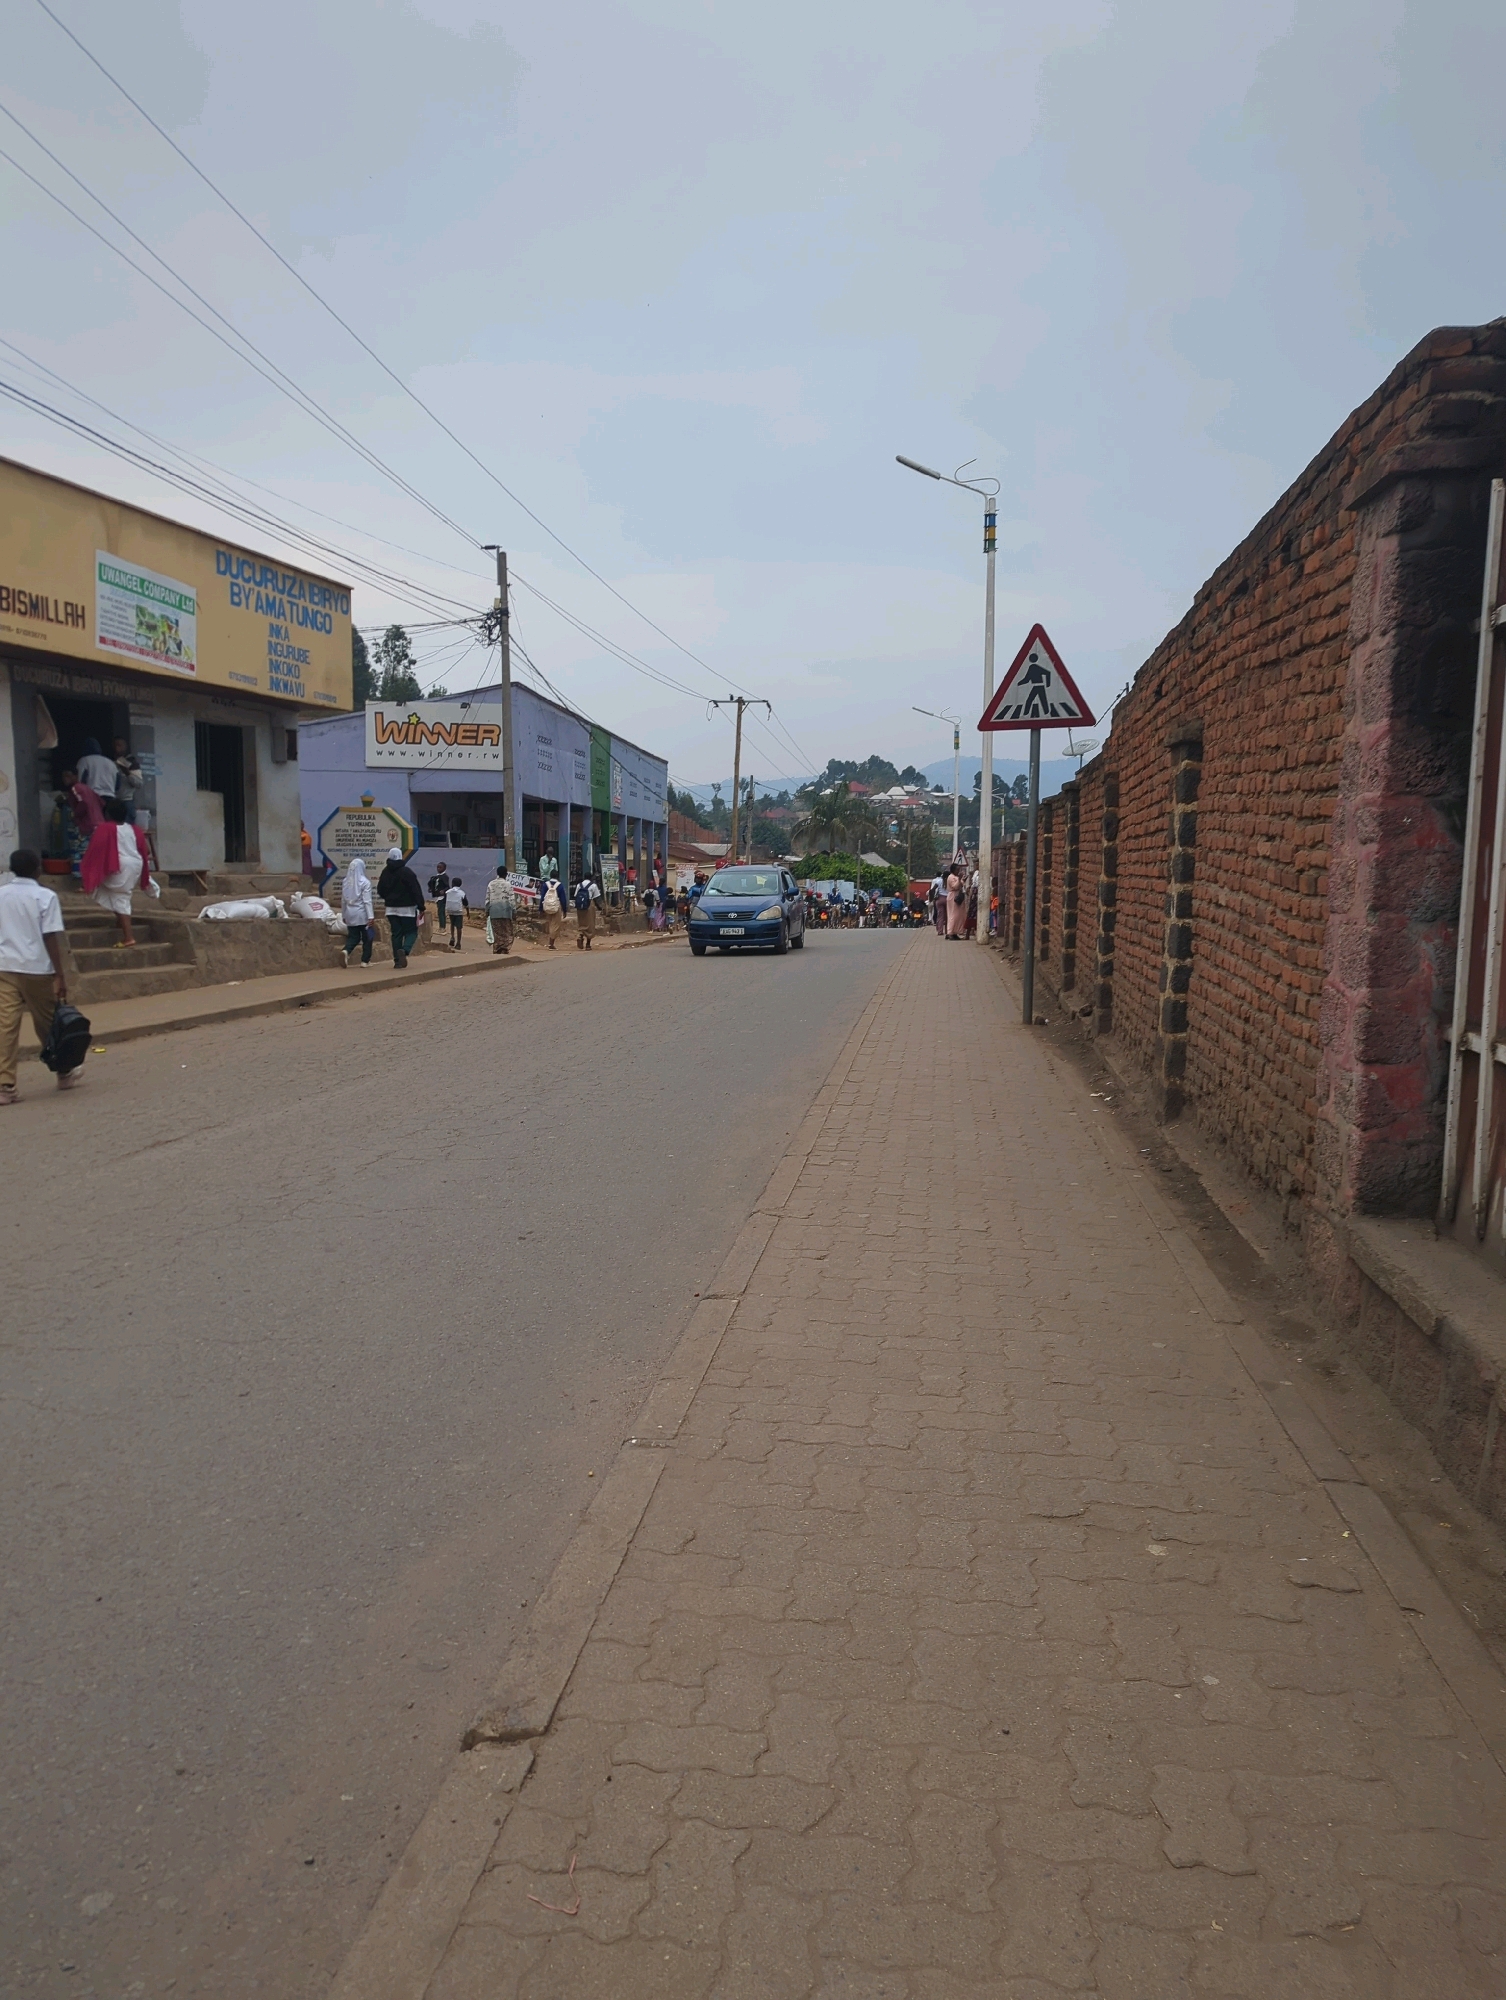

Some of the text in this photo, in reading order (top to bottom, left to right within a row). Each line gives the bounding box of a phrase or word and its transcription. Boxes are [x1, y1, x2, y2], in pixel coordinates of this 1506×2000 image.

[143, 580, 180, 606] COMPANY
[216, 549, 350, 615] DUCURUZA IBIRYO
[0, 585, 86, 630] BISMILLAH
[374, 711, 501, 747] WINNER
[511, 873, 525, 881] CITY
